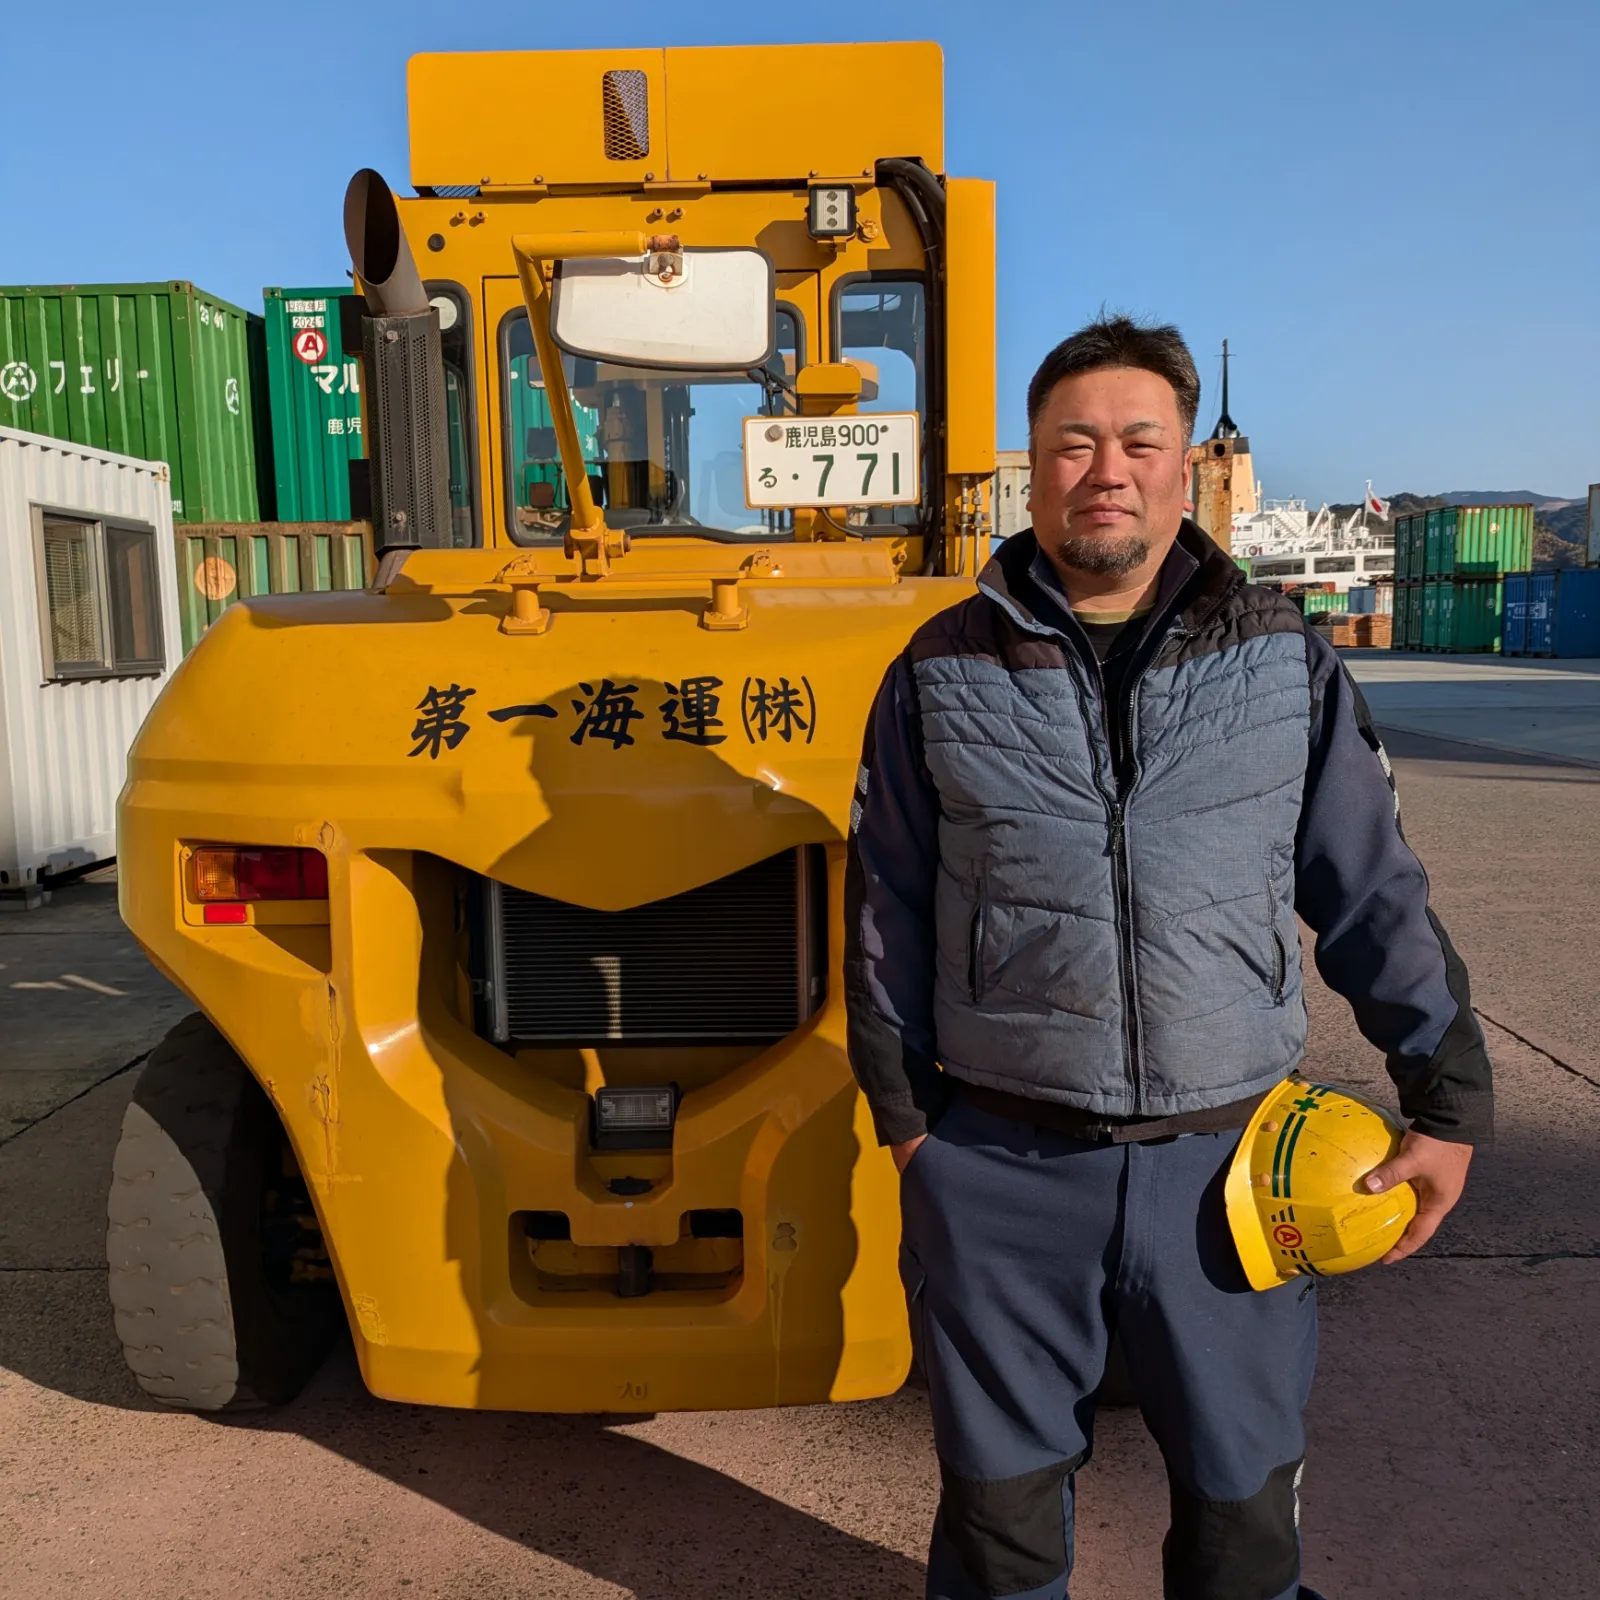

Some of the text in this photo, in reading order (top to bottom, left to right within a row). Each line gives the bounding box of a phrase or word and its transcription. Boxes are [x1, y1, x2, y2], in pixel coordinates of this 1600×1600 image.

[310, 363, 360, 394] マル
[406, 675, 817, 760] 第一海運(株)
